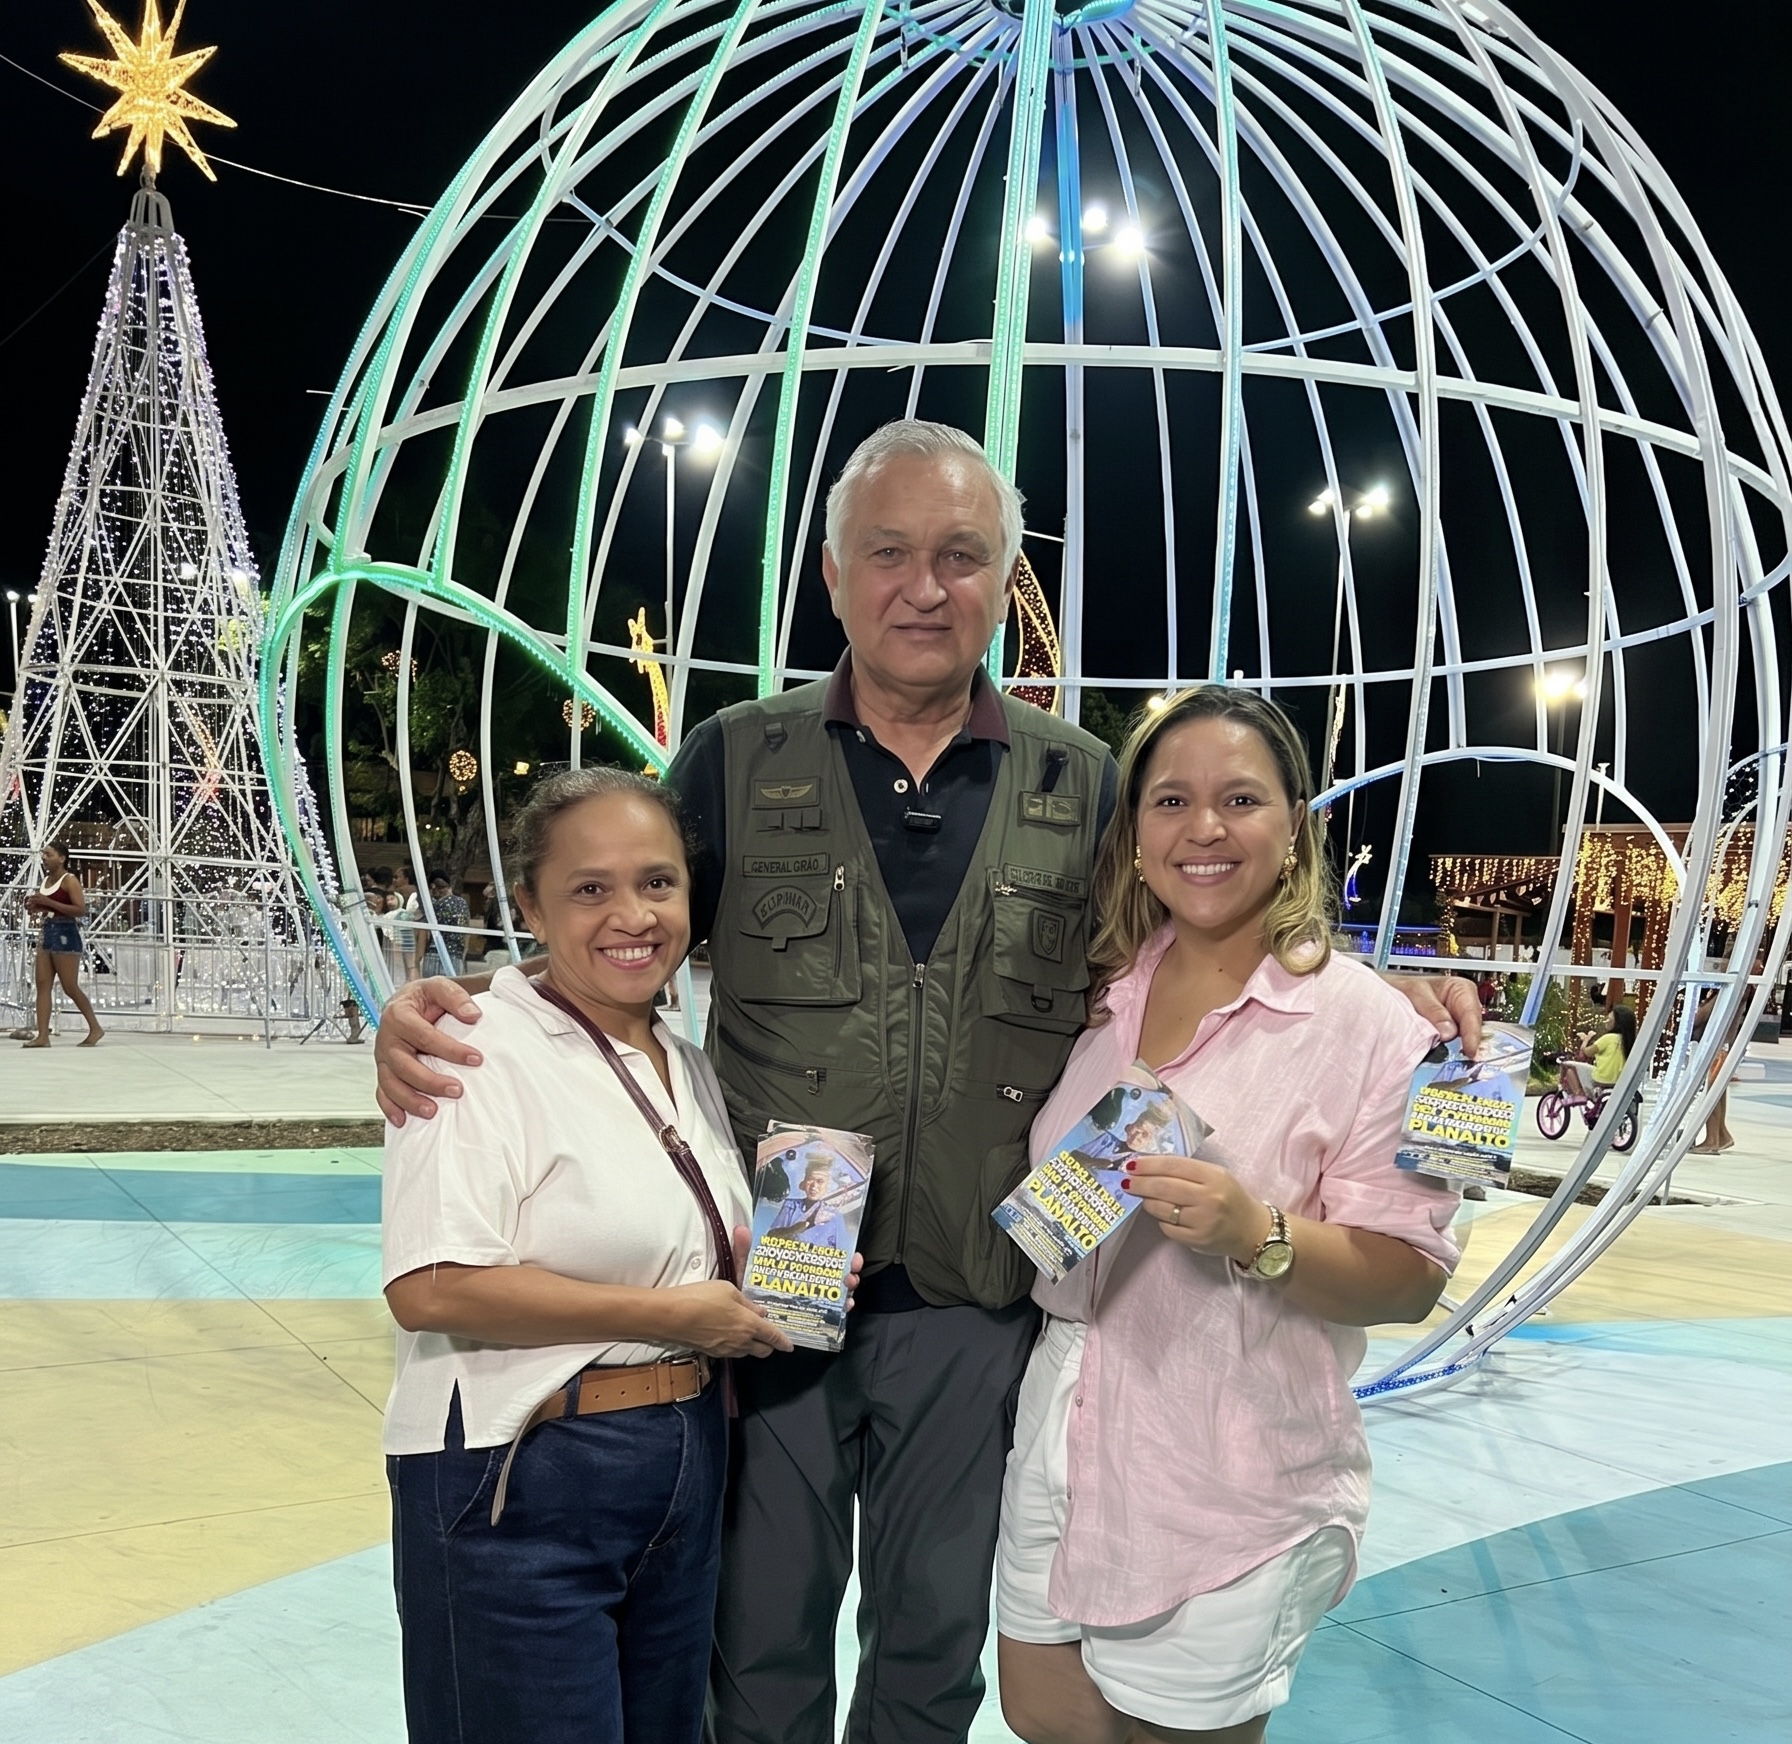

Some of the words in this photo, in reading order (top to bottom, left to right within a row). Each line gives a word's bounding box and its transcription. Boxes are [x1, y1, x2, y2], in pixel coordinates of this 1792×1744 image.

[751, 861, 792, 874] GENERAL
[1027, 1176, 1097, 1250] PLANALTO
[749, 1272, 842, 1302] PLANALTO
